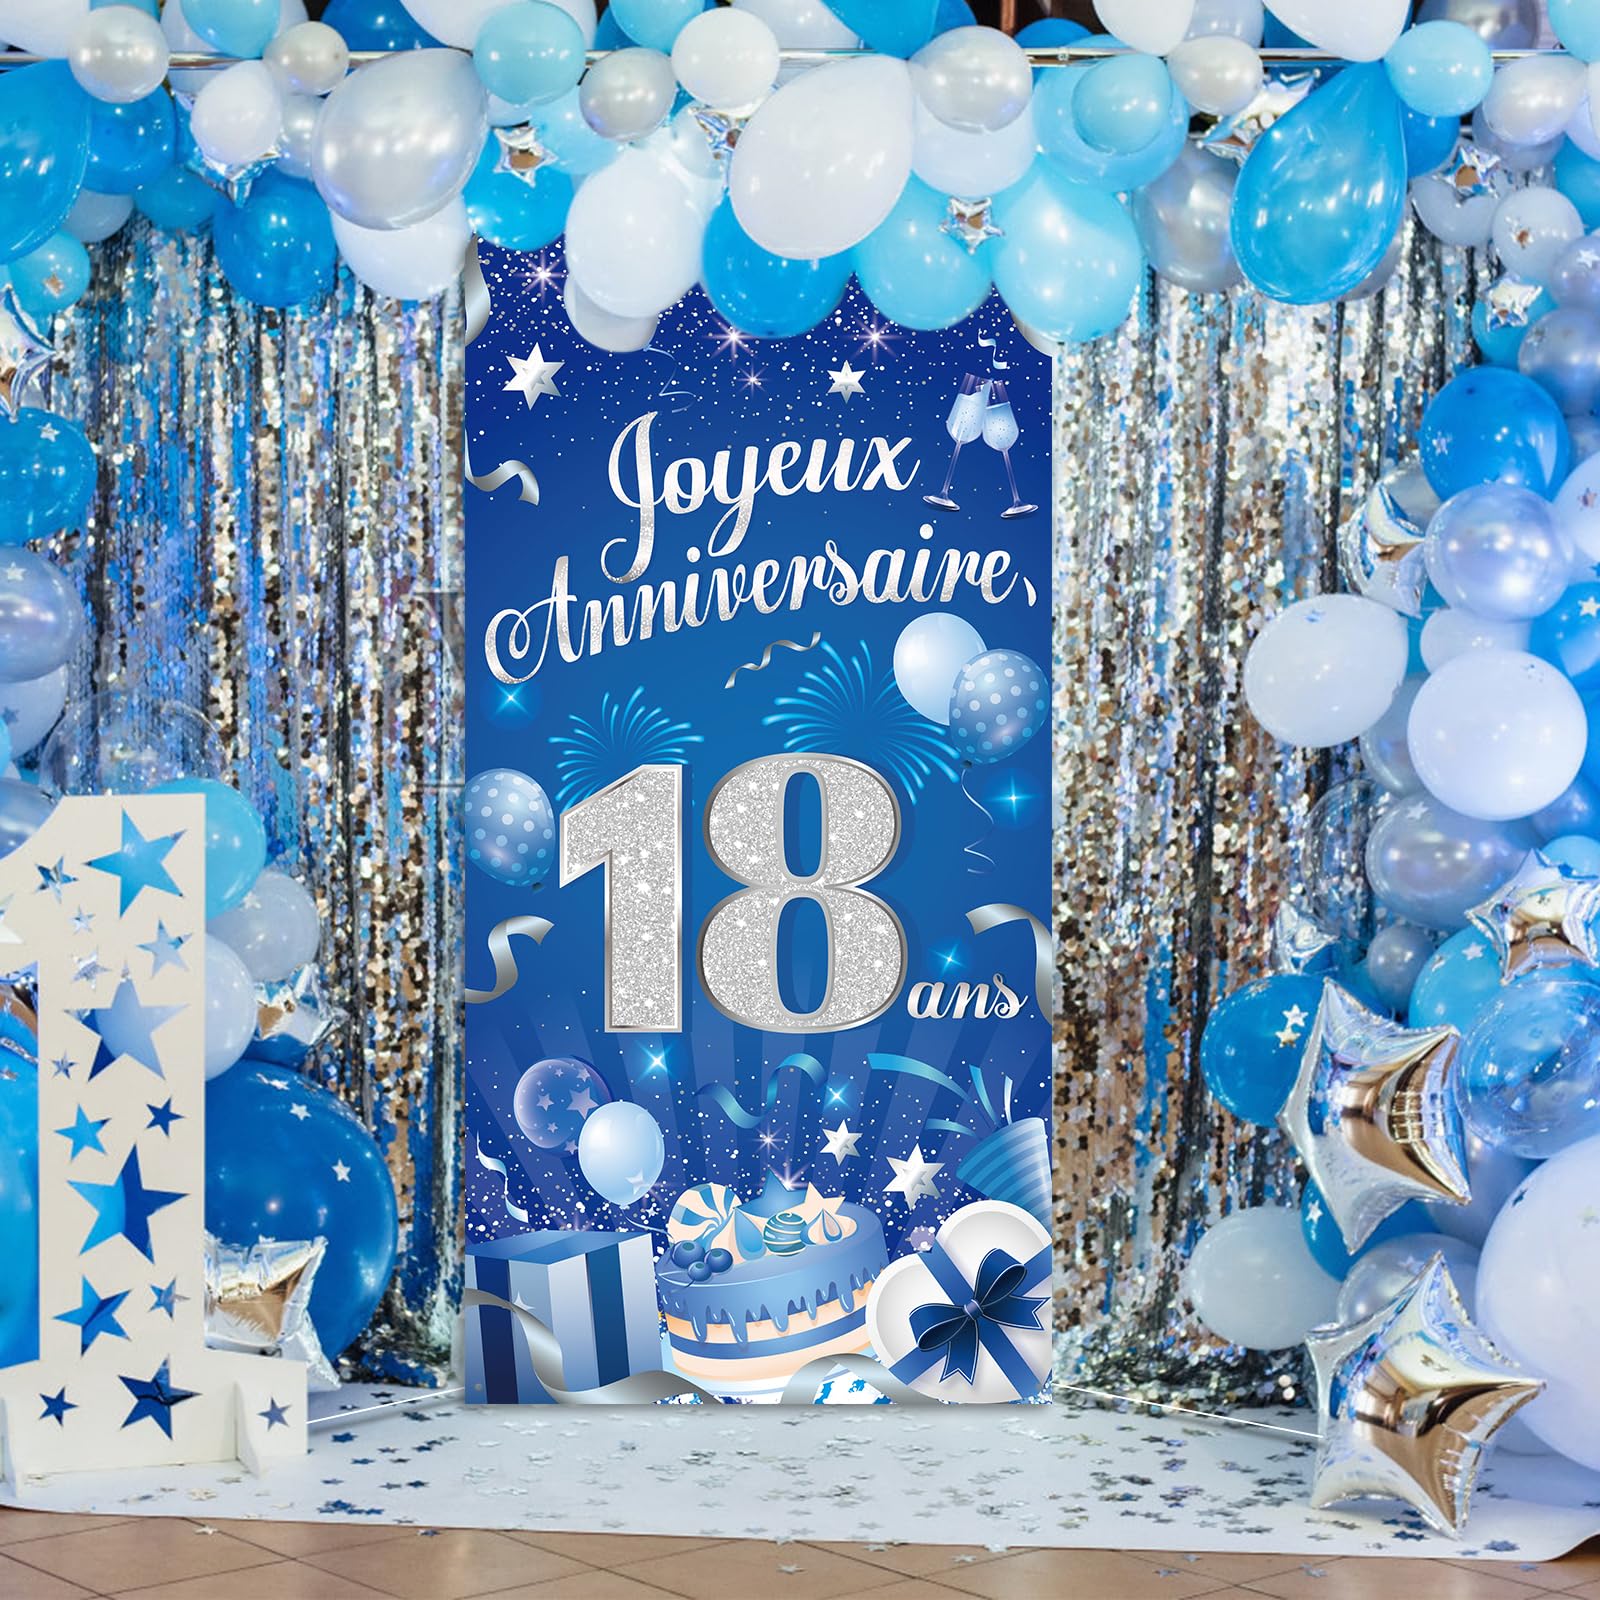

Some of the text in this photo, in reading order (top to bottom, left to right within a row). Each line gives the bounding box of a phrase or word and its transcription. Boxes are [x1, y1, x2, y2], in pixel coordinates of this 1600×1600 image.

[601, 411, 921, 584] Joyeux
[559, 752, 1029, 1034] 18 ans
